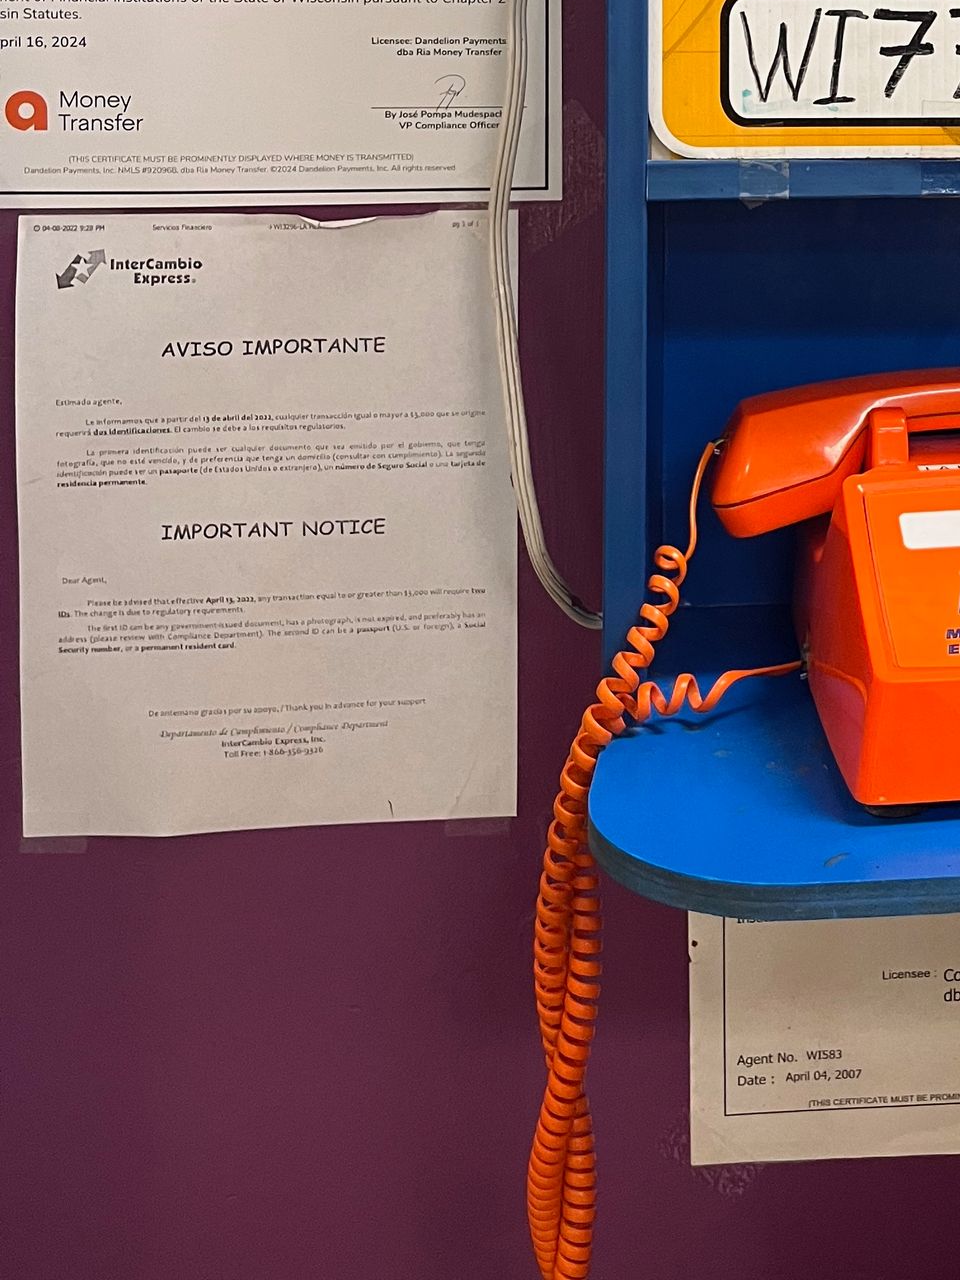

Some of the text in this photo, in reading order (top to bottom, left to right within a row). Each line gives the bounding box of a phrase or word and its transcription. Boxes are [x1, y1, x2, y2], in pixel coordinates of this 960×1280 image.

[27, 36, 46, 48] 16,
[52, 36, 86, 47] 2024
[58, 91, 131, 115] Money
[58, 113, 143, 131] Transfer
[111, 258, 202, 270] InterCambio
[162, 337, 385, 357] AVISO IMPORTANTE
[162, 518, 385, 540] IMPORTANT NOTICE
[881, 969, 931, 981] Licensee
[737, 1054, 773, 1068] Agent
[778, 1053, 798, 1063] No.
[737, 1068, 863, 1087] Date April 04, 2007
